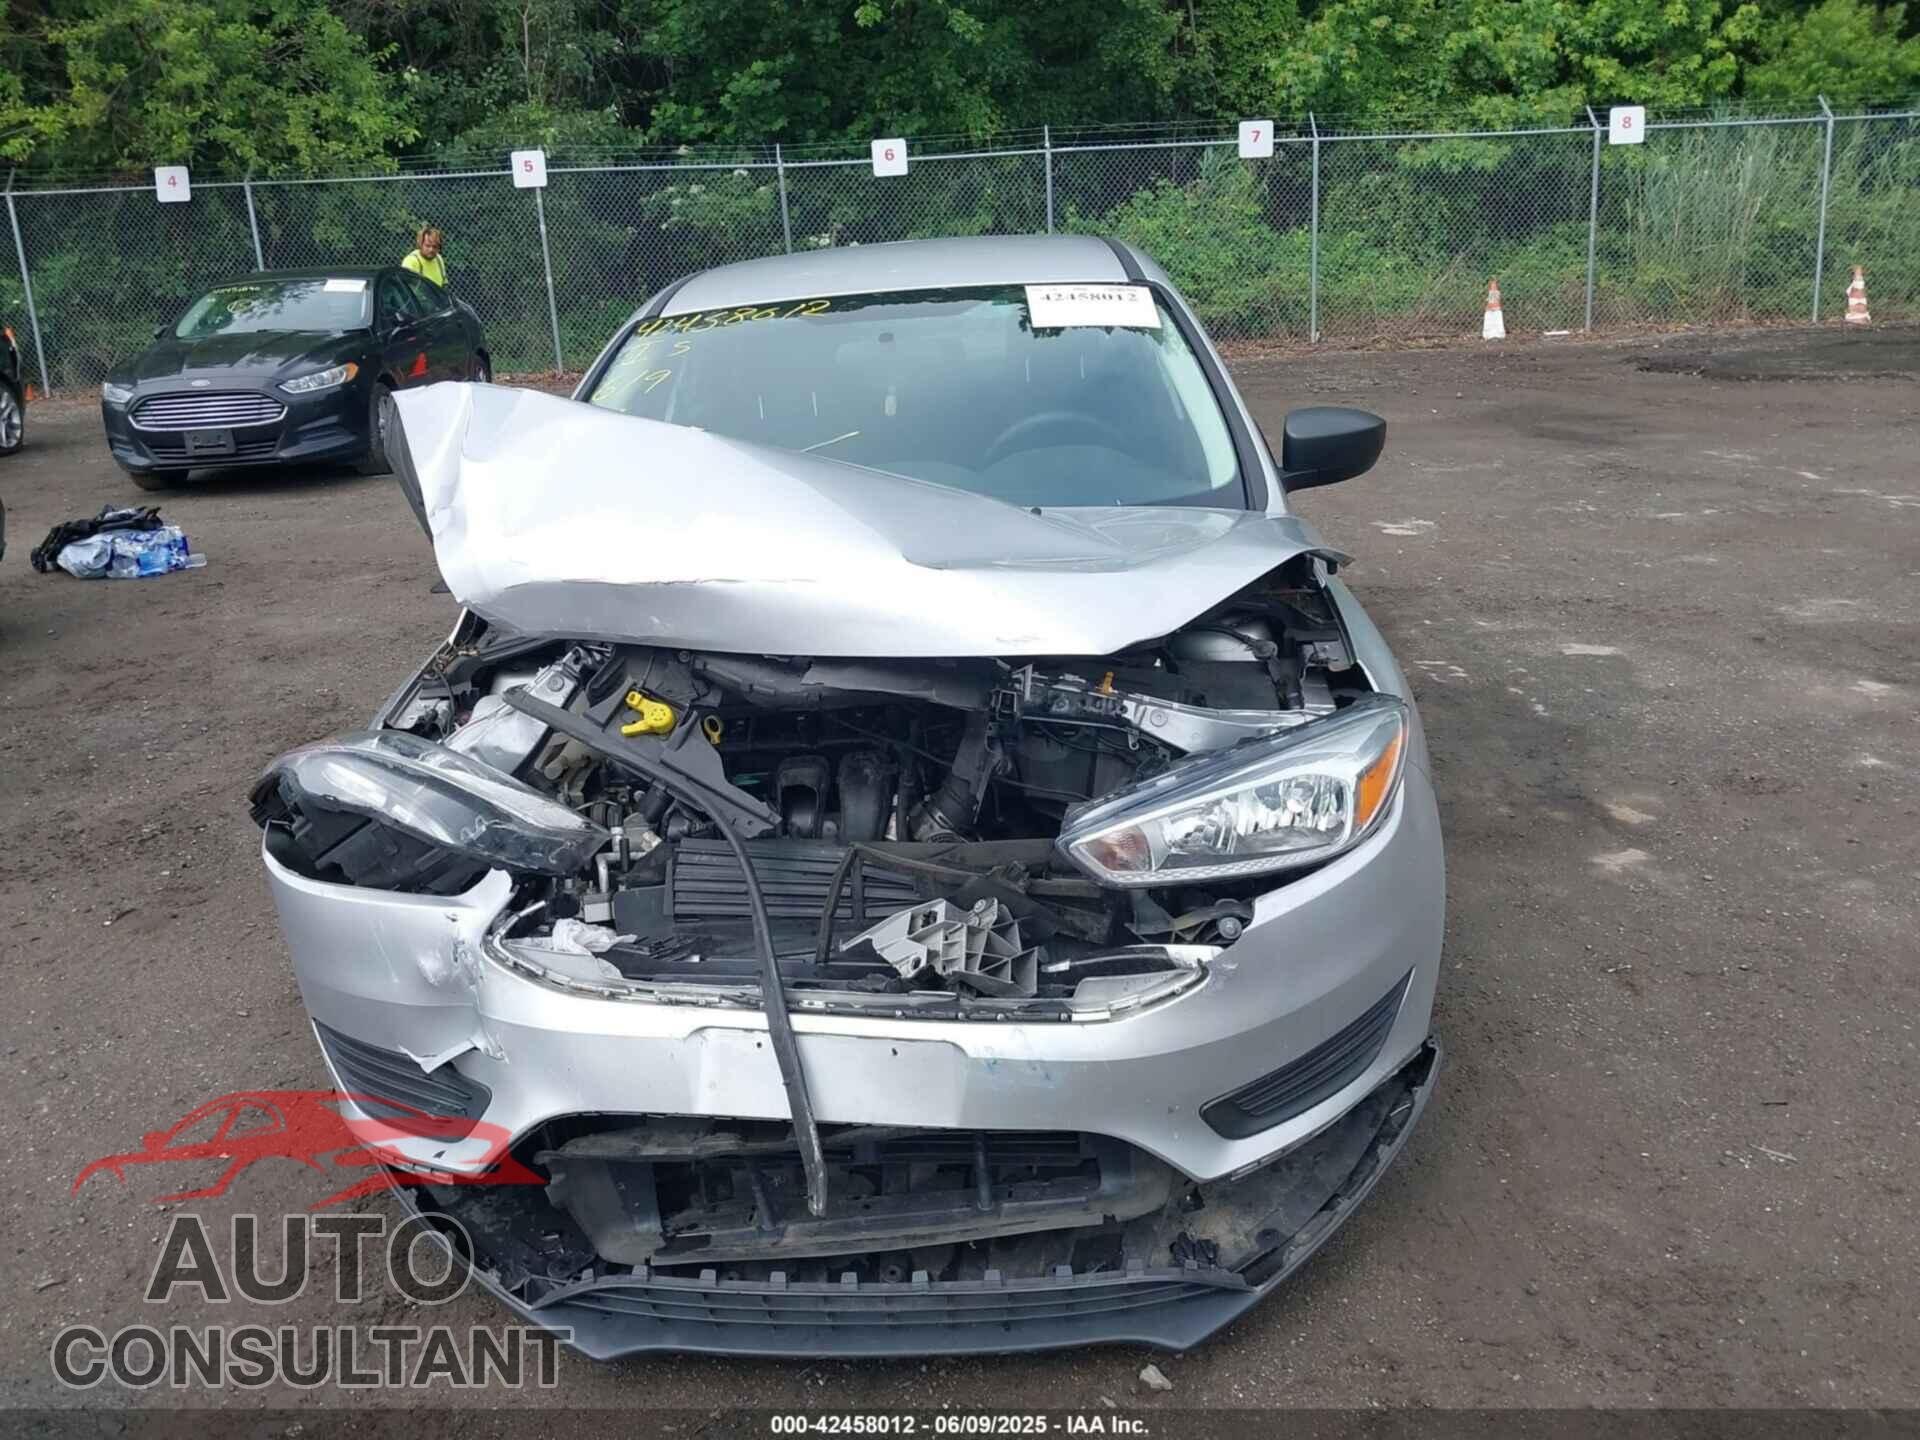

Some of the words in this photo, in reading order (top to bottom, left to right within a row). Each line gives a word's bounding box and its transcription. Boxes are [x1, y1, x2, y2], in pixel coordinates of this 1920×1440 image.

[1621, 115, 1632, 129] 8
[1251, 129, 1262, 144] 7
[884, 148, 896, 162] 6
[522, 160, 535, 173] 5
[167, 175, 178, 188] 4
